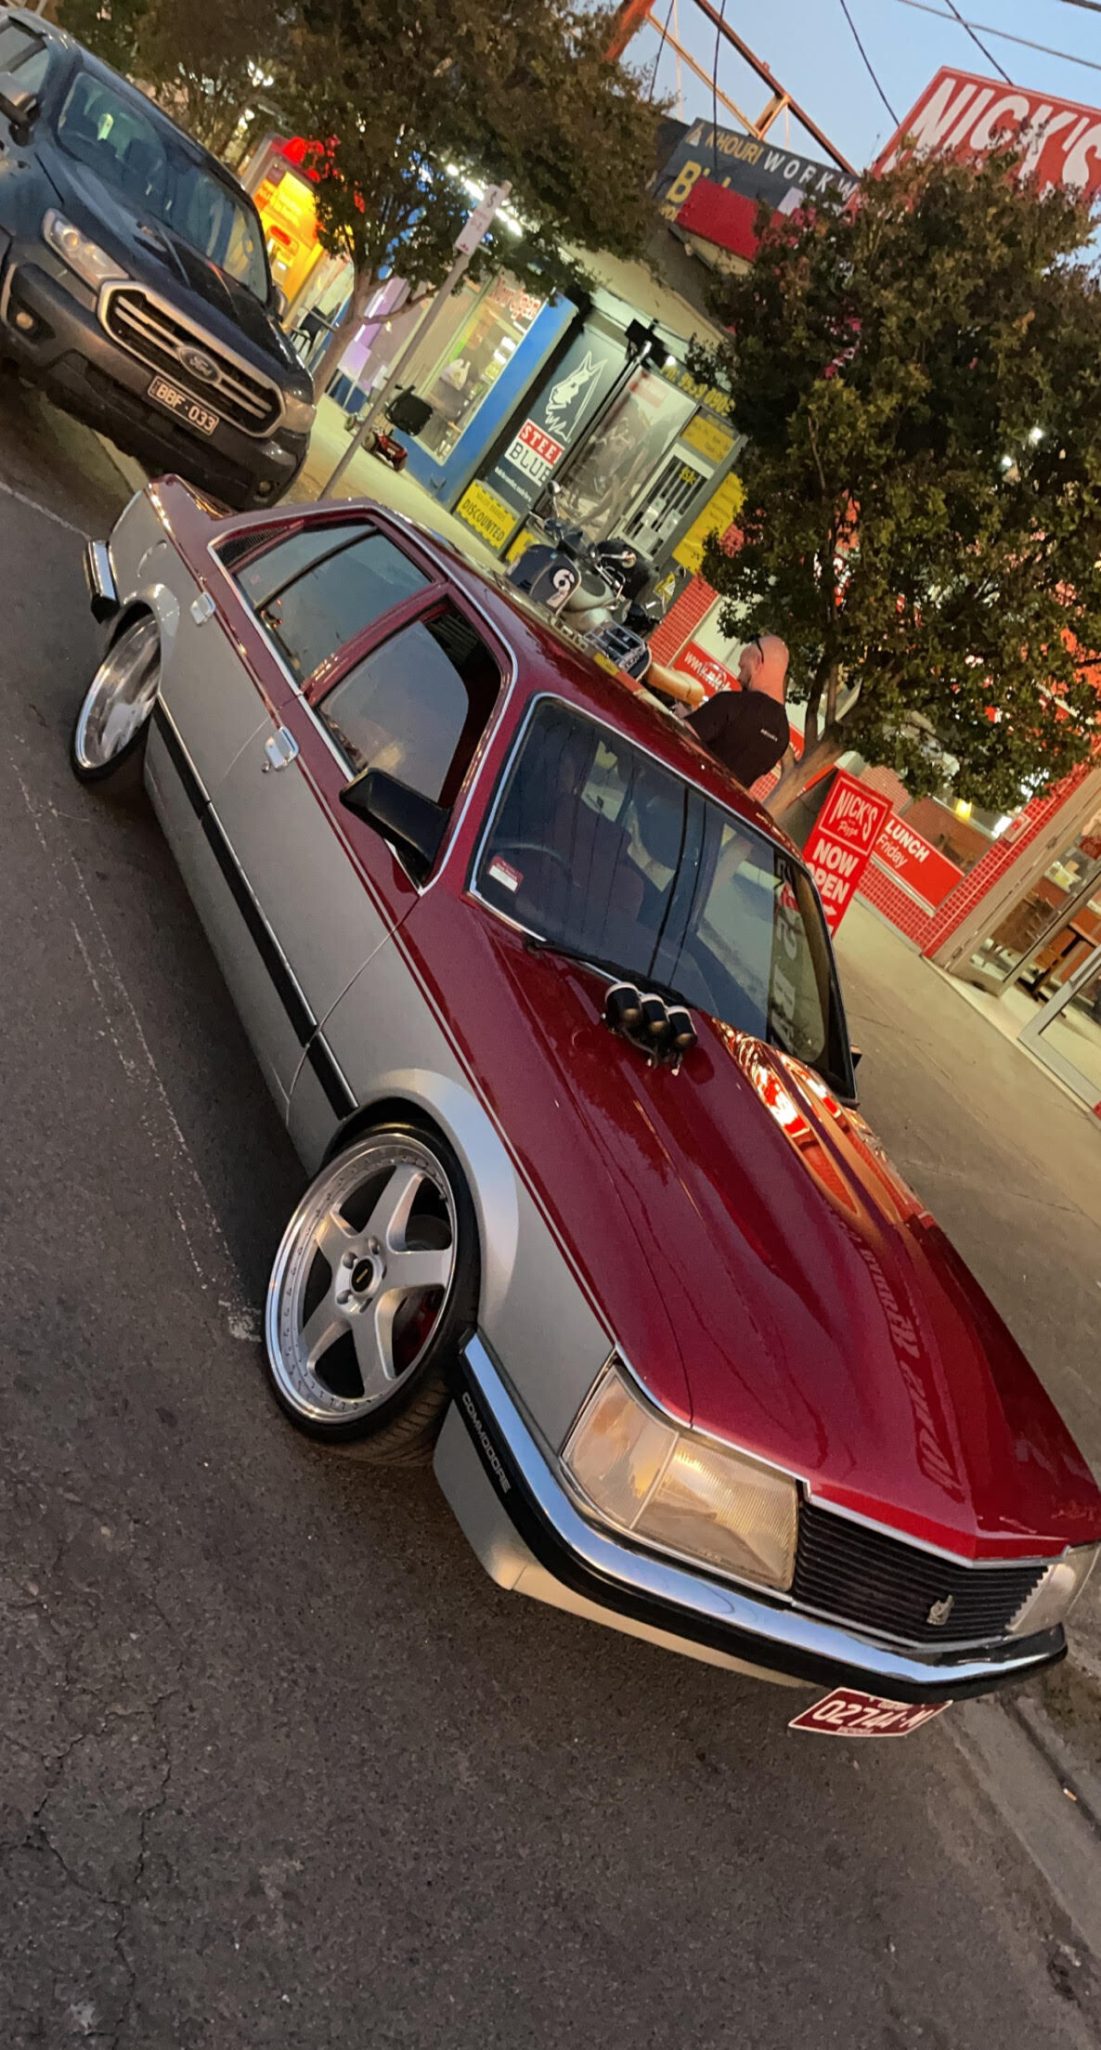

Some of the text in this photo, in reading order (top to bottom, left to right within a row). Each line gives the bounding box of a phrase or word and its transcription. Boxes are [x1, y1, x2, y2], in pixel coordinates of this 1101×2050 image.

[705, 131, 763, 166] KHOURI
[764, 151, 860, 201] WORKW
[509, 442, 551, 482] BLUE
[520, 424, 562, 464] STEE
[462, 498, 505, 541] DISCOUNTED
[828, 788, 878, 842] NICK'S
[812, 838, 859, 878] NOW
[875, 834, 908, 869] Friday
[884, 819, 930, 863] LUNCH
[462, 1387, 511, 1493] COMMODORE
